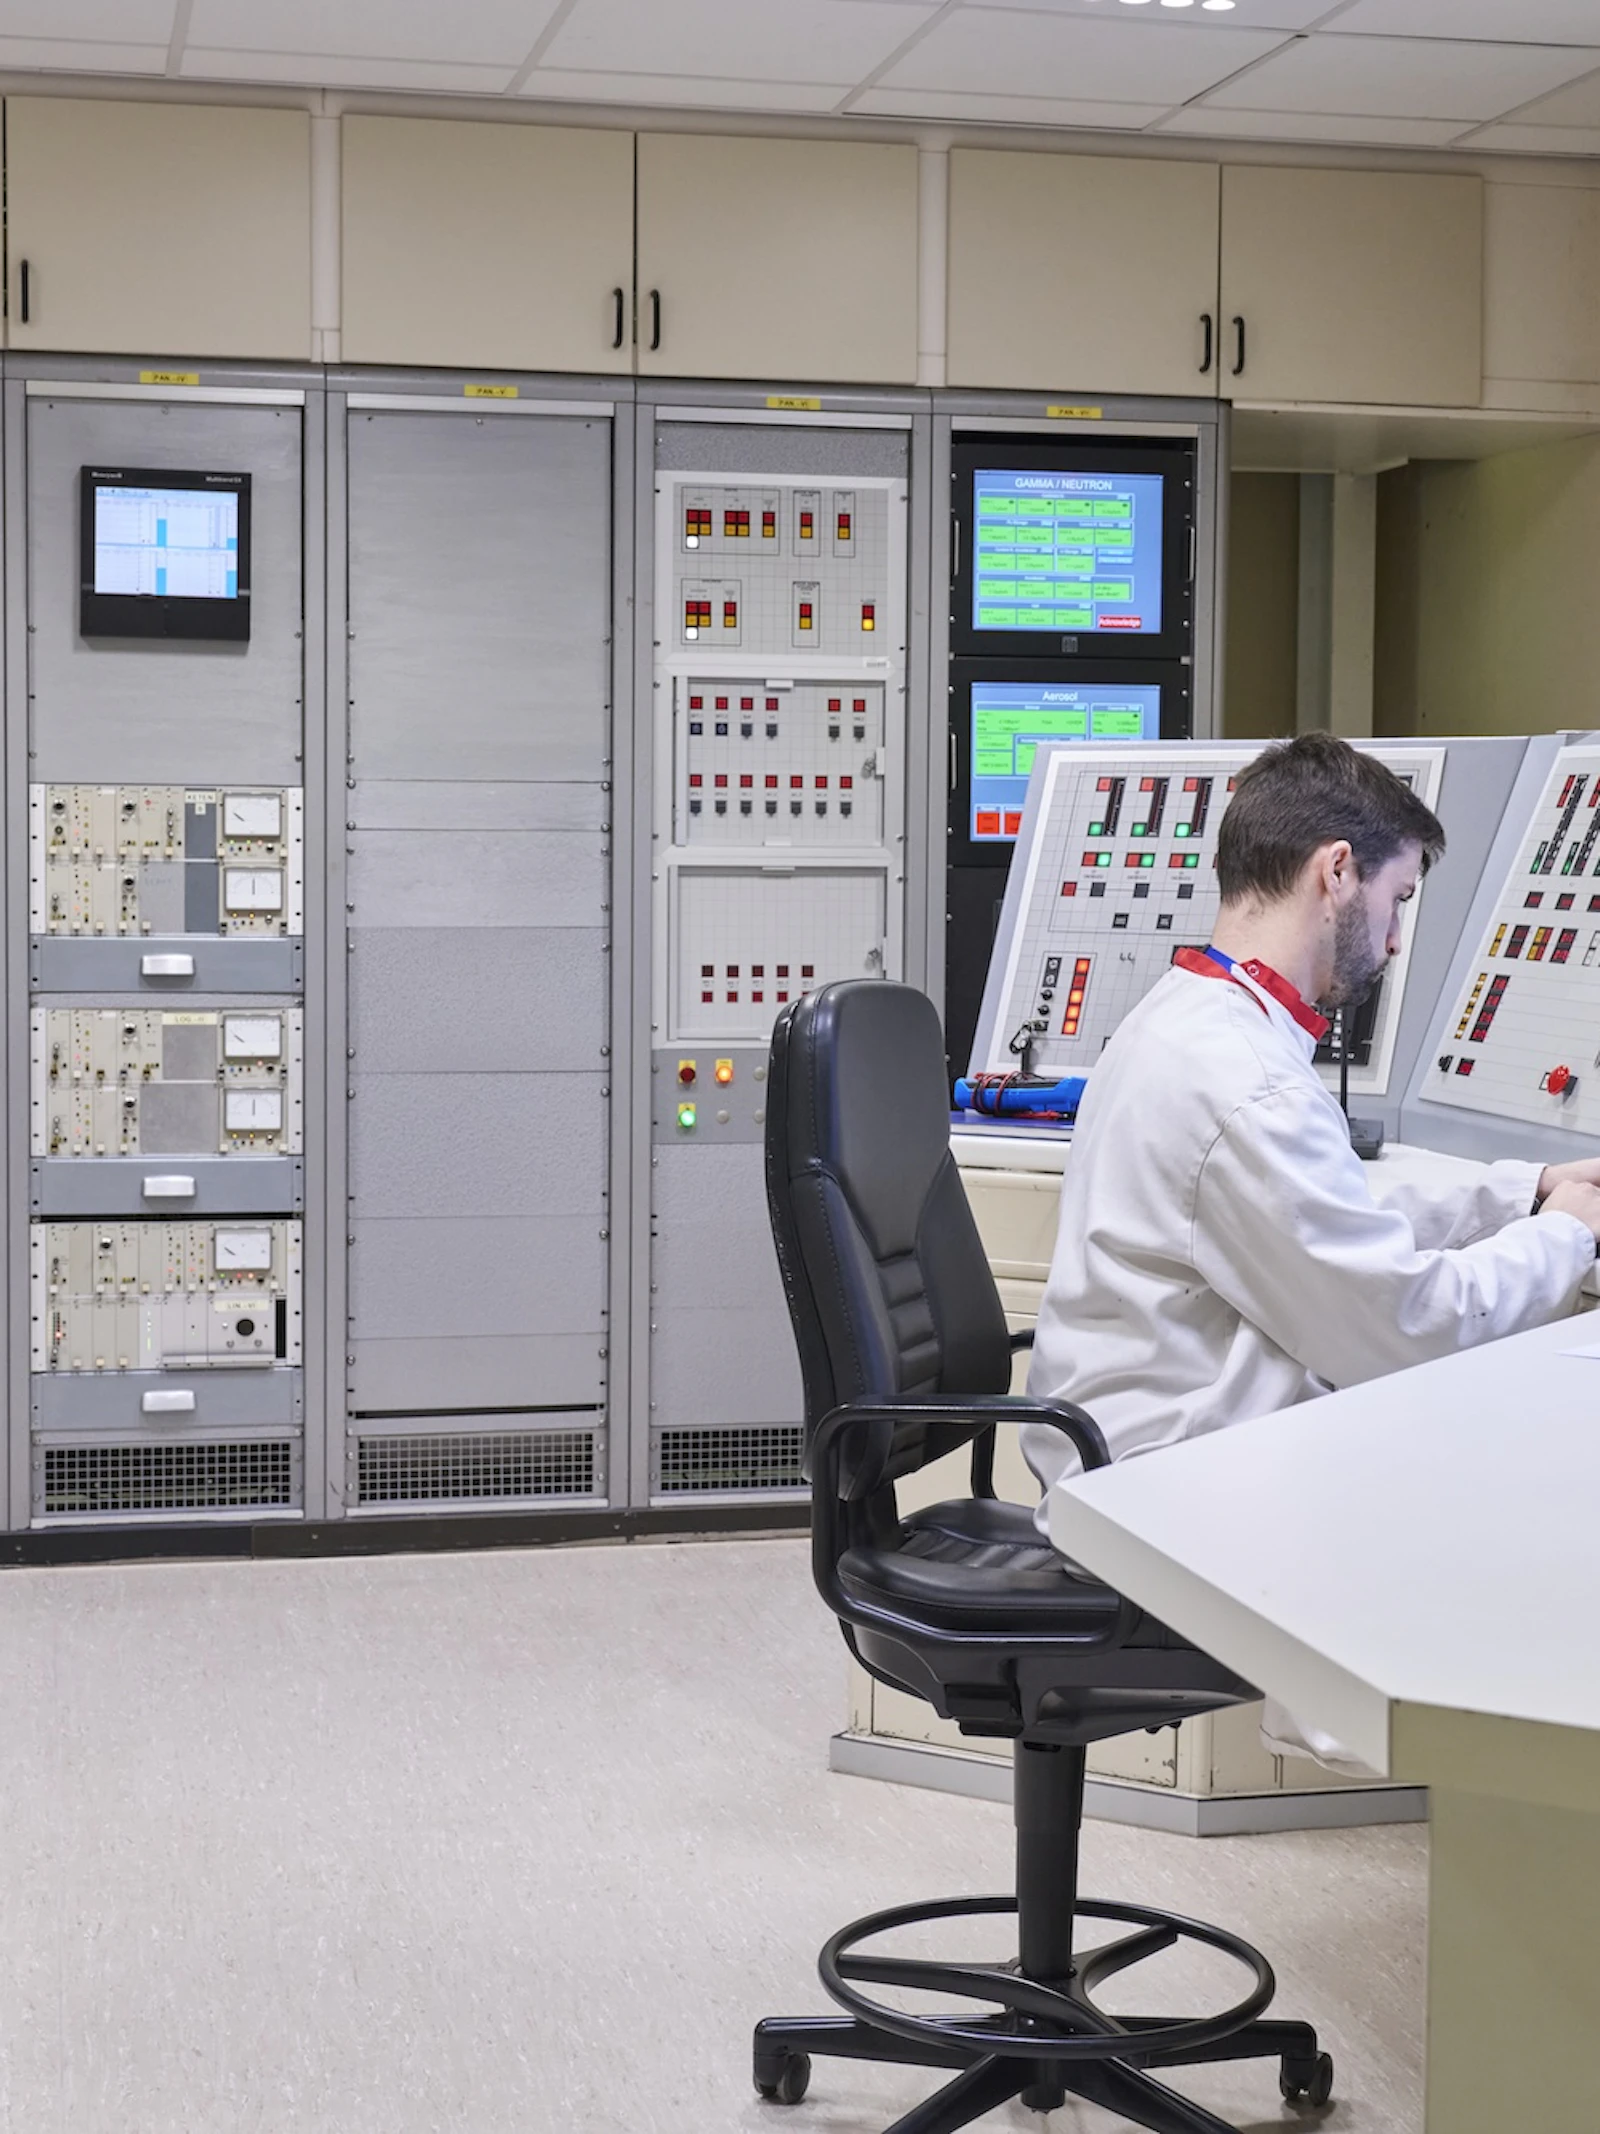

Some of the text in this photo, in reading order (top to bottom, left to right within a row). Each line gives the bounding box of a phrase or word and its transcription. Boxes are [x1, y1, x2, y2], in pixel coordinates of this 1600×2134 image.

[1014, 477, 1054, 489] GAMMA
[1061, 479, 1112, 491] NEUTRON
[1099, 617, 1141, 628] Acknowledge
[1042, 691, 1078, 702] Aerosol
